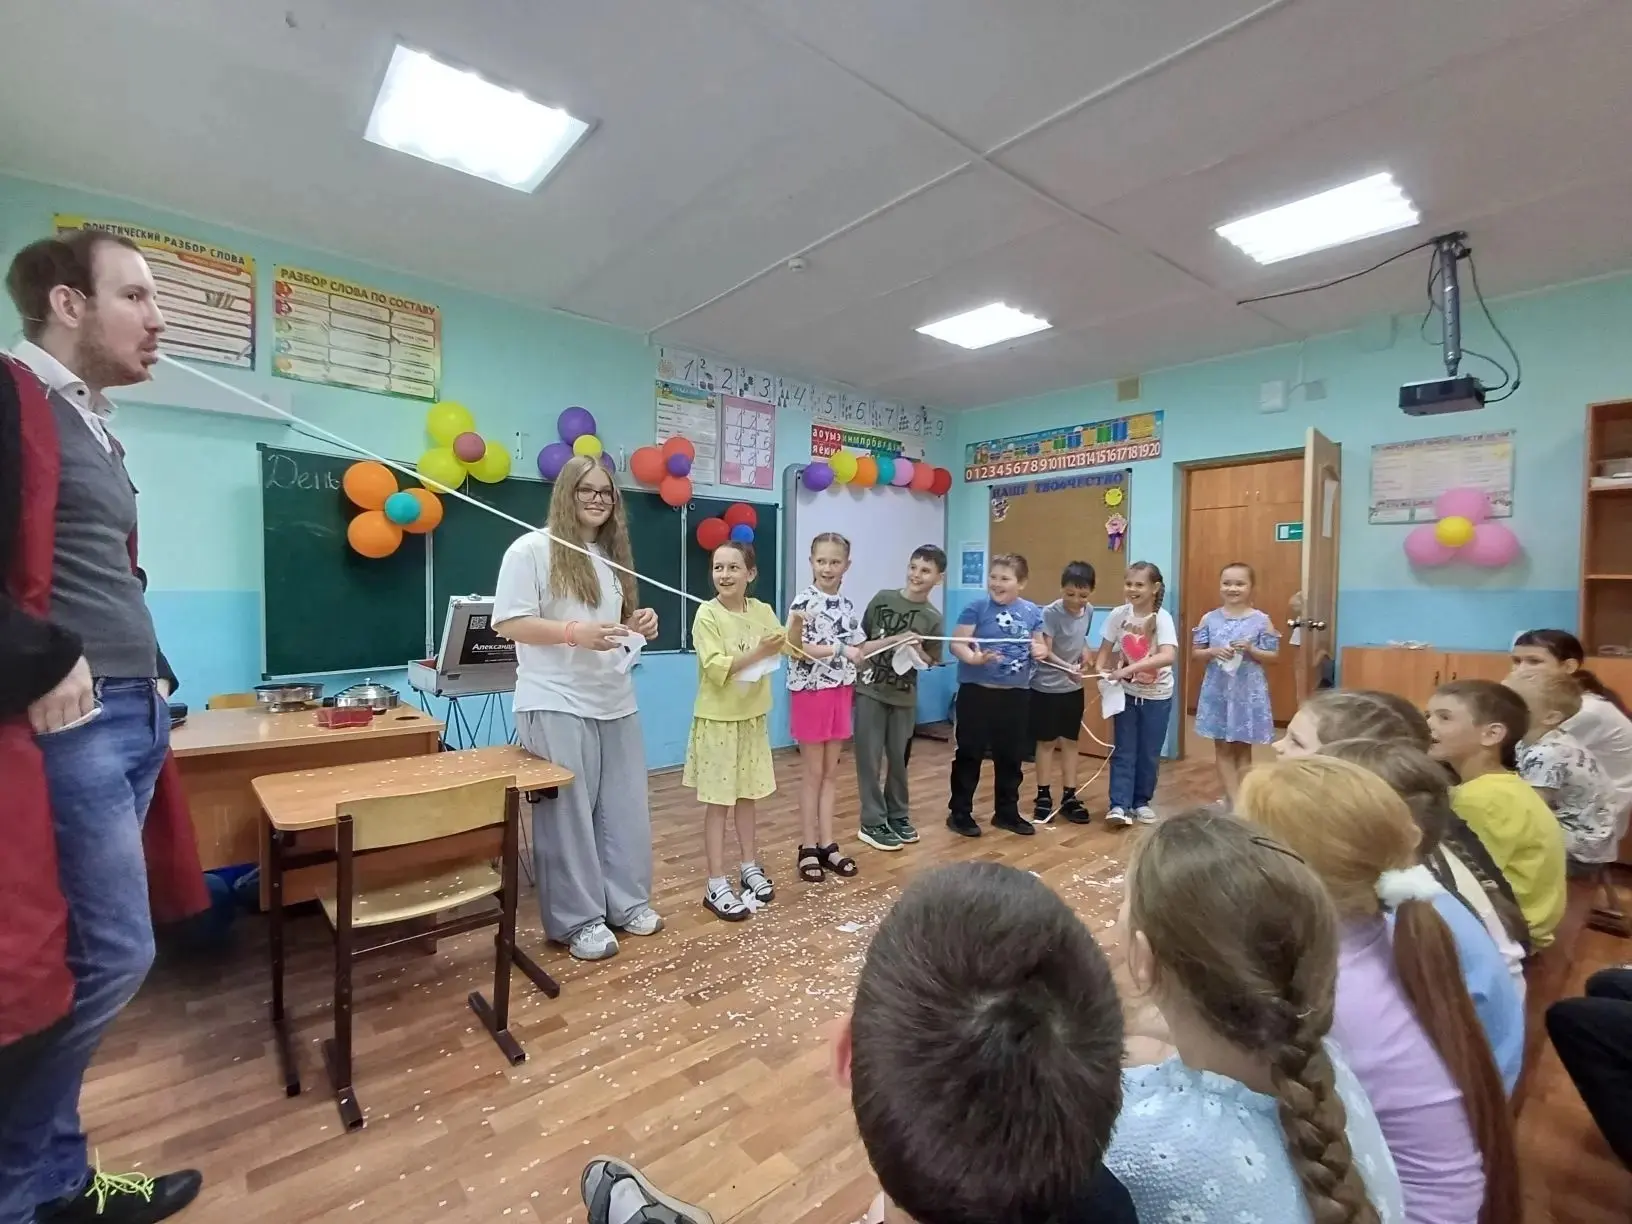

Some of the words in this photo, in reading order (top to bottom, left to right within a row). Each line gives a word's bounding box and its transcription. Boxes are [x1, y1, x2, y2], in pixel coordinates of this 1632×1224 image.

[163, 235, 209, 254] РАЗБОР
[210, 248, 246, 265] СЛОВА
[280, 267, 328, 288] РАЗБОР
[330, 281, 369, 299] СЛОВА
[371, 291, 387, 304] ПО
[389, 296, 436, 316] СОСТАВУ
[684, 360, 694, 380] 1
[721, 368, 733, 390] 2
[759, 377, 771, 398] 3
[793, 387, 807, 406] 4
[824, 395, 837, 414] 5
[855, 401, 867, 420] 6
[885, 407, 895, 425] 7
[936, 420, 944, 437] 9
[265, 454, 342, 490] День
[966, 469, 972, 480] 0
[974, 468, 979, 479] 1
[981, 467, 988, 478] 2
[988, 466, 996, 477] 3
[996, 464, 1004, 476] 4
[1005, 463, 1012, 475] 5
[1013, 462, 1021, 474] 6
[1022, 461, 1029, 473] 7
[1030, 460, 1038, 472] 8
[1040, 458, 1048, 471] 9
[1049, 458, 1057, 470] 10
[1058, 456, 1066, 468] 11
[1066, 455, 1076, 467] 12
[1076, 453, 1085, 466] 13
[1086, 452, 1095, 465] 14
[1096, 450, 1106, 463] 15
[1106, 449, 1116, 462] 16
[1117, 447, 1127, 460] 17
[1128, 446, 1138, 459] 18
[1139, 444, 1149, 457] 19
[1149, 442, 1160, 456] 20
[875, 604, 920, 635] TRUST
[472, 643, 516, 651] Александр
